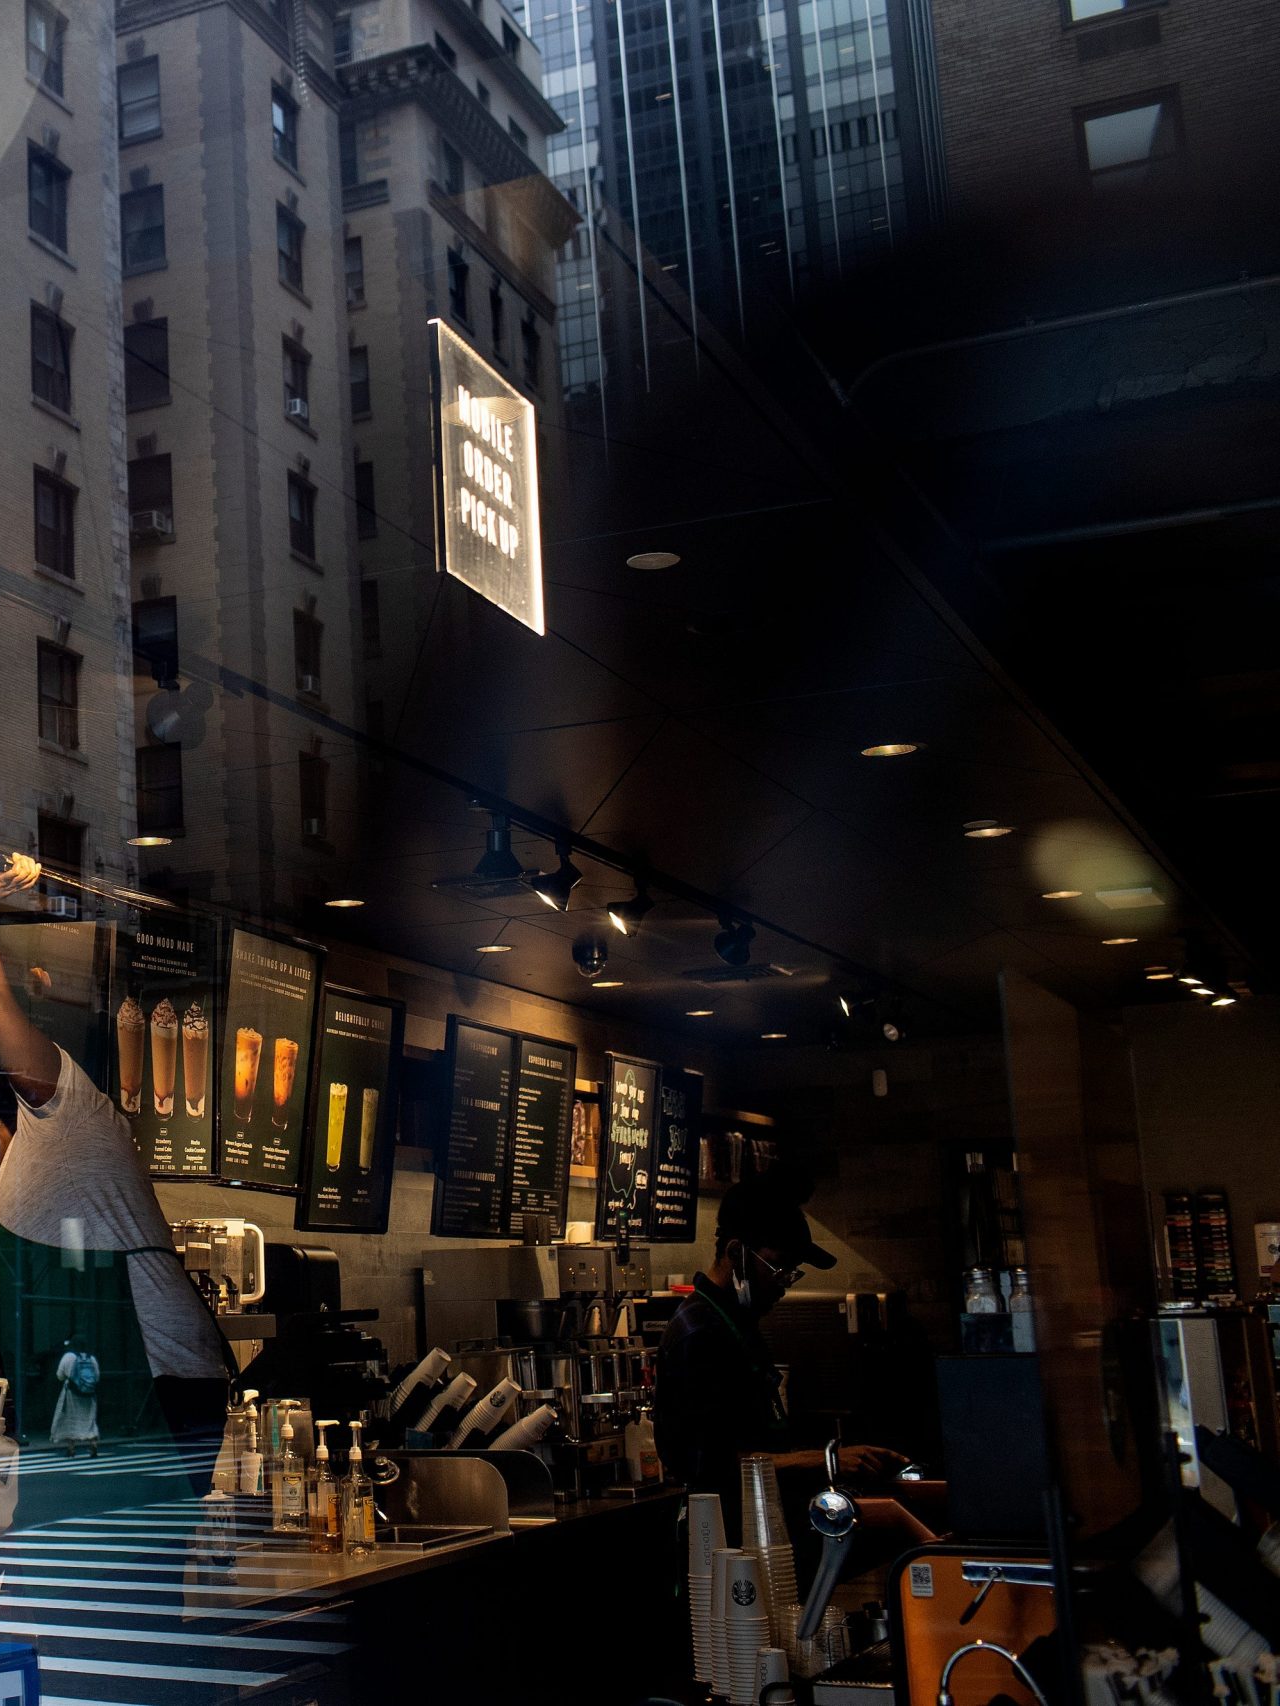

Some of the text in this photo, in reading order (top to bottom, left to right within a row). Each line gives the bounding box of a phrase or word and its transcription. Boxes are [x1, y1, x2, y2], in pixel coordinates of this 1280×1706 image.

[458, 384, 514, 462] MOBILE
[463, 440, 513, 509] ORDER
[136, 932, 194, 953] GOOD MOOD MADE
[236, 949, 311, 981] SHAKE THINGS UP A LITTLE
[335, 1010, 370, 1027] DELIGHTFULLY
[528, 1054, 546, 1067] ESPRESSO
